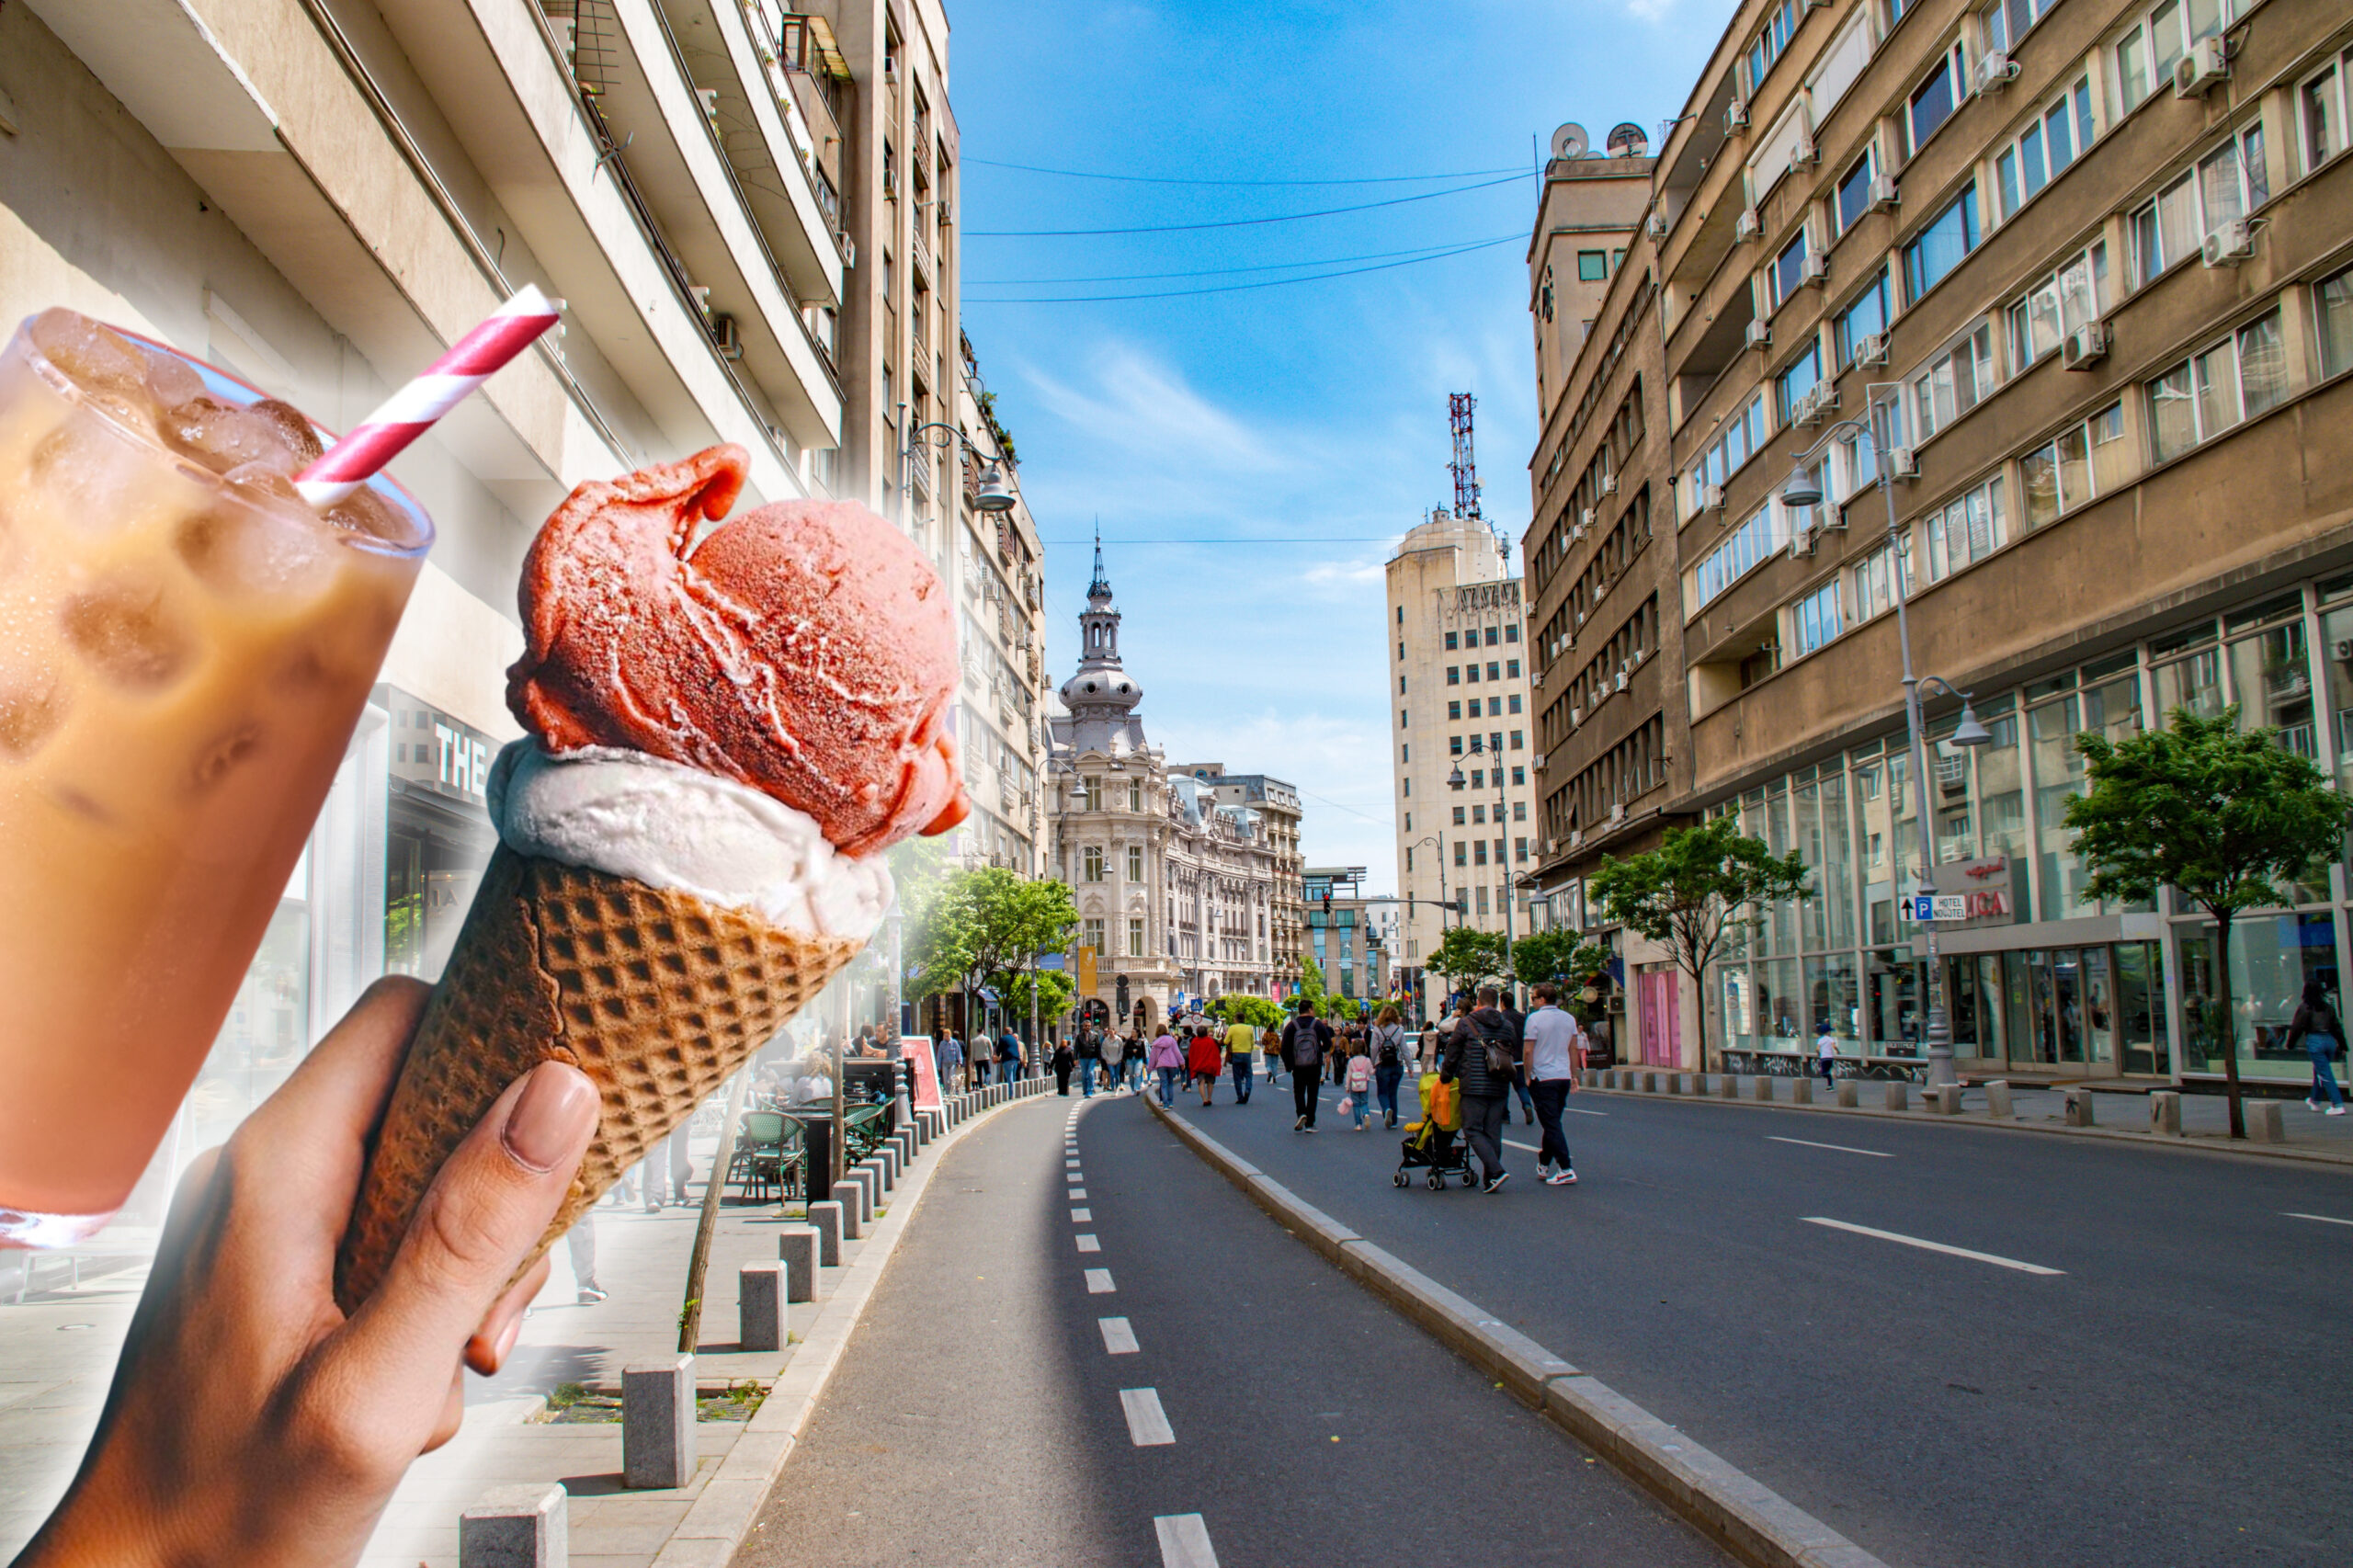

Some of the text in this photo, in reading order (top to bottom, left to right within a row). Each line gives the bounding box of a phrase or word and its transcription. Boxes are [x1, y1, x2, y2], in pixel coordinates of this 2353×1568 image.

[436, 722, 486, 798] THE
[1920, 897, 1962, 916] P HOTEL
[1965, 891, 2008, 919] ICA
